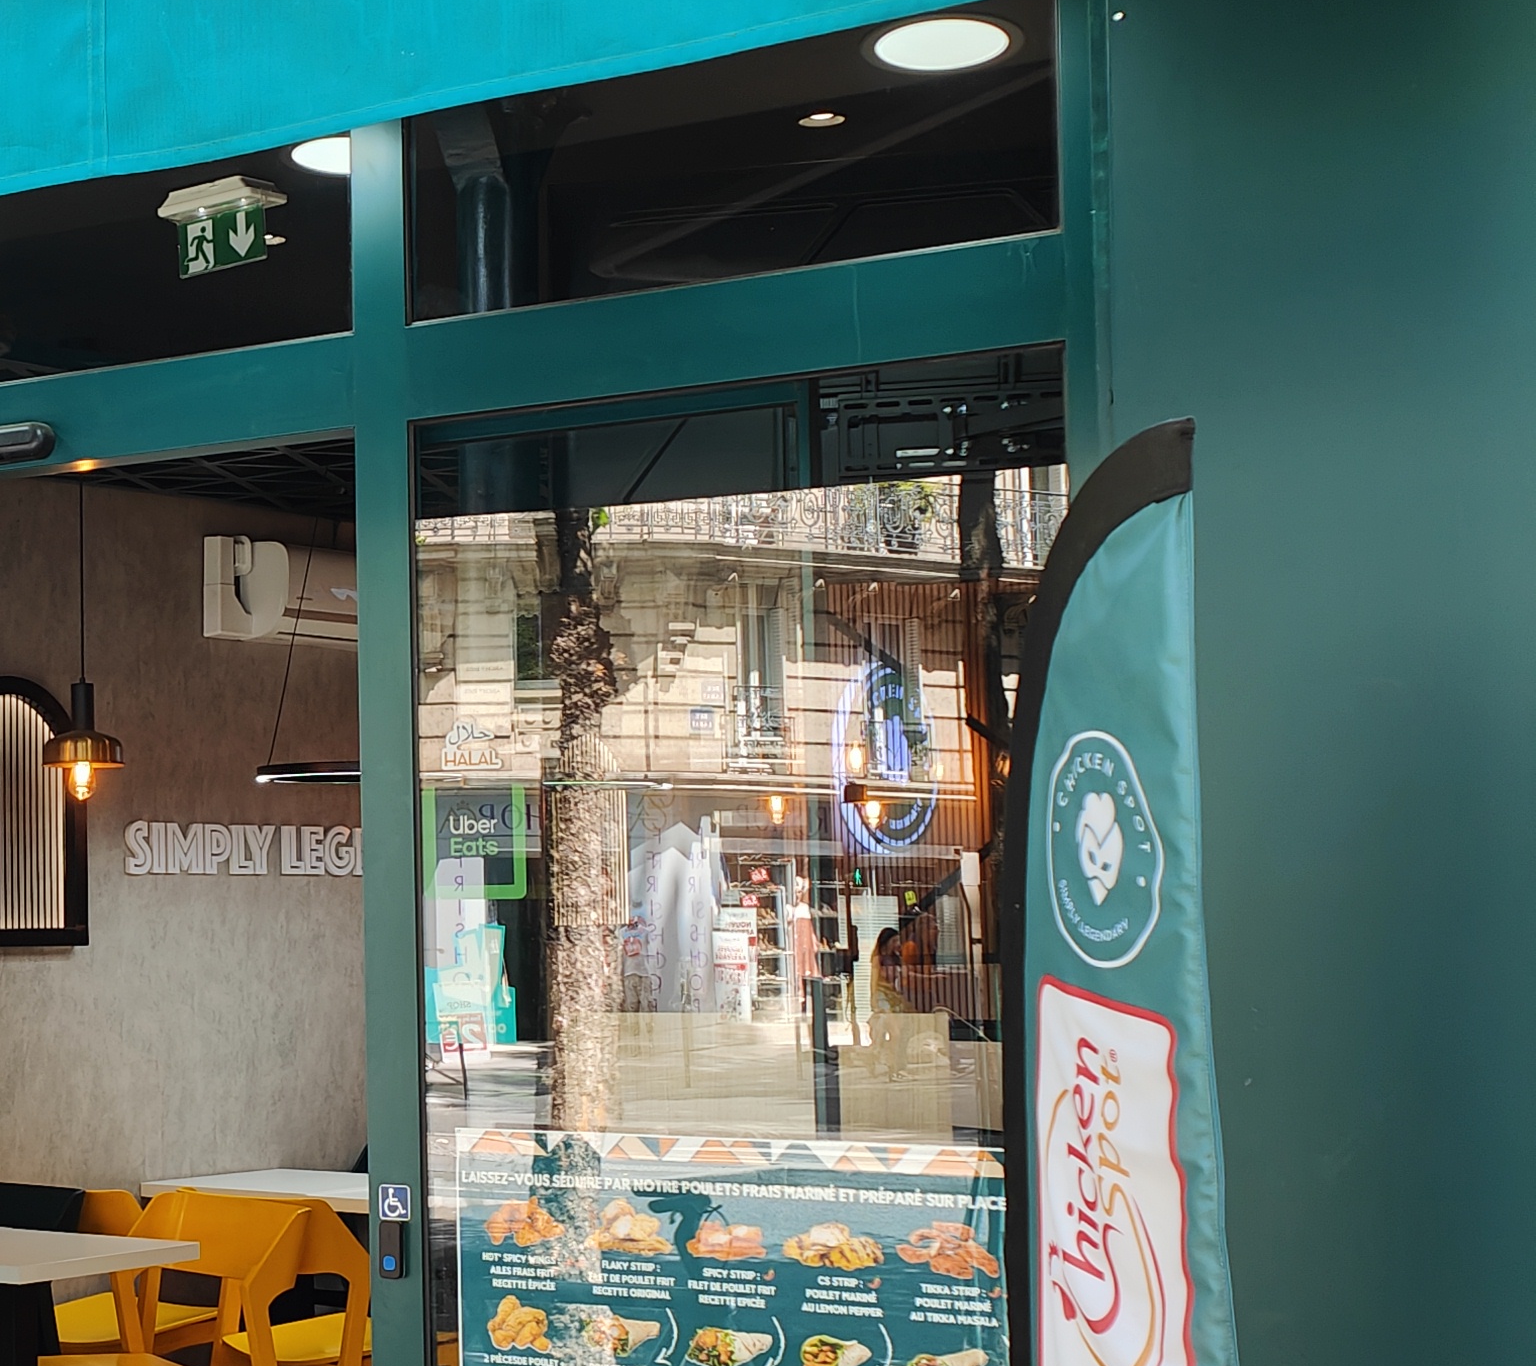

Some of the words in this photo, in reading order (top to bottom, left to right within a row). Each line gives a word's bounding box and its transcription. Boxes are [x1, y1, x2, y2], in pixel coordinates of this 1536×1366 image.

[448, 723, 491, 745] حلال
[444, 750, 499, 767] HALAL
[1056, 752, 1115, 807] CHICKEN
[1117, 780, 1151, 853] SPOT
[449, 815, 498, 835] Uber
[124, 820, 276, 875] SIMPLY
[280, 825, 363, 876] LEG
[449, 838, 499, 856] Eats
[461, 1170, 551, 1186] LAISSEZ-VOUS
[604, 1178, 631, 1191] PAR
[634, 1178, 679, 1193] NOTRE
[682, 1180, 740, 1196] POULETS
[743, 1184, 781, 1199] FRAIS
[839, 1189, 854, 1203] ET
[926, 1192, 954, 1208] SUR
[958, 1194, 1007, 1212] PLACE
[602, 1260, 629, 1271] FLAKY
